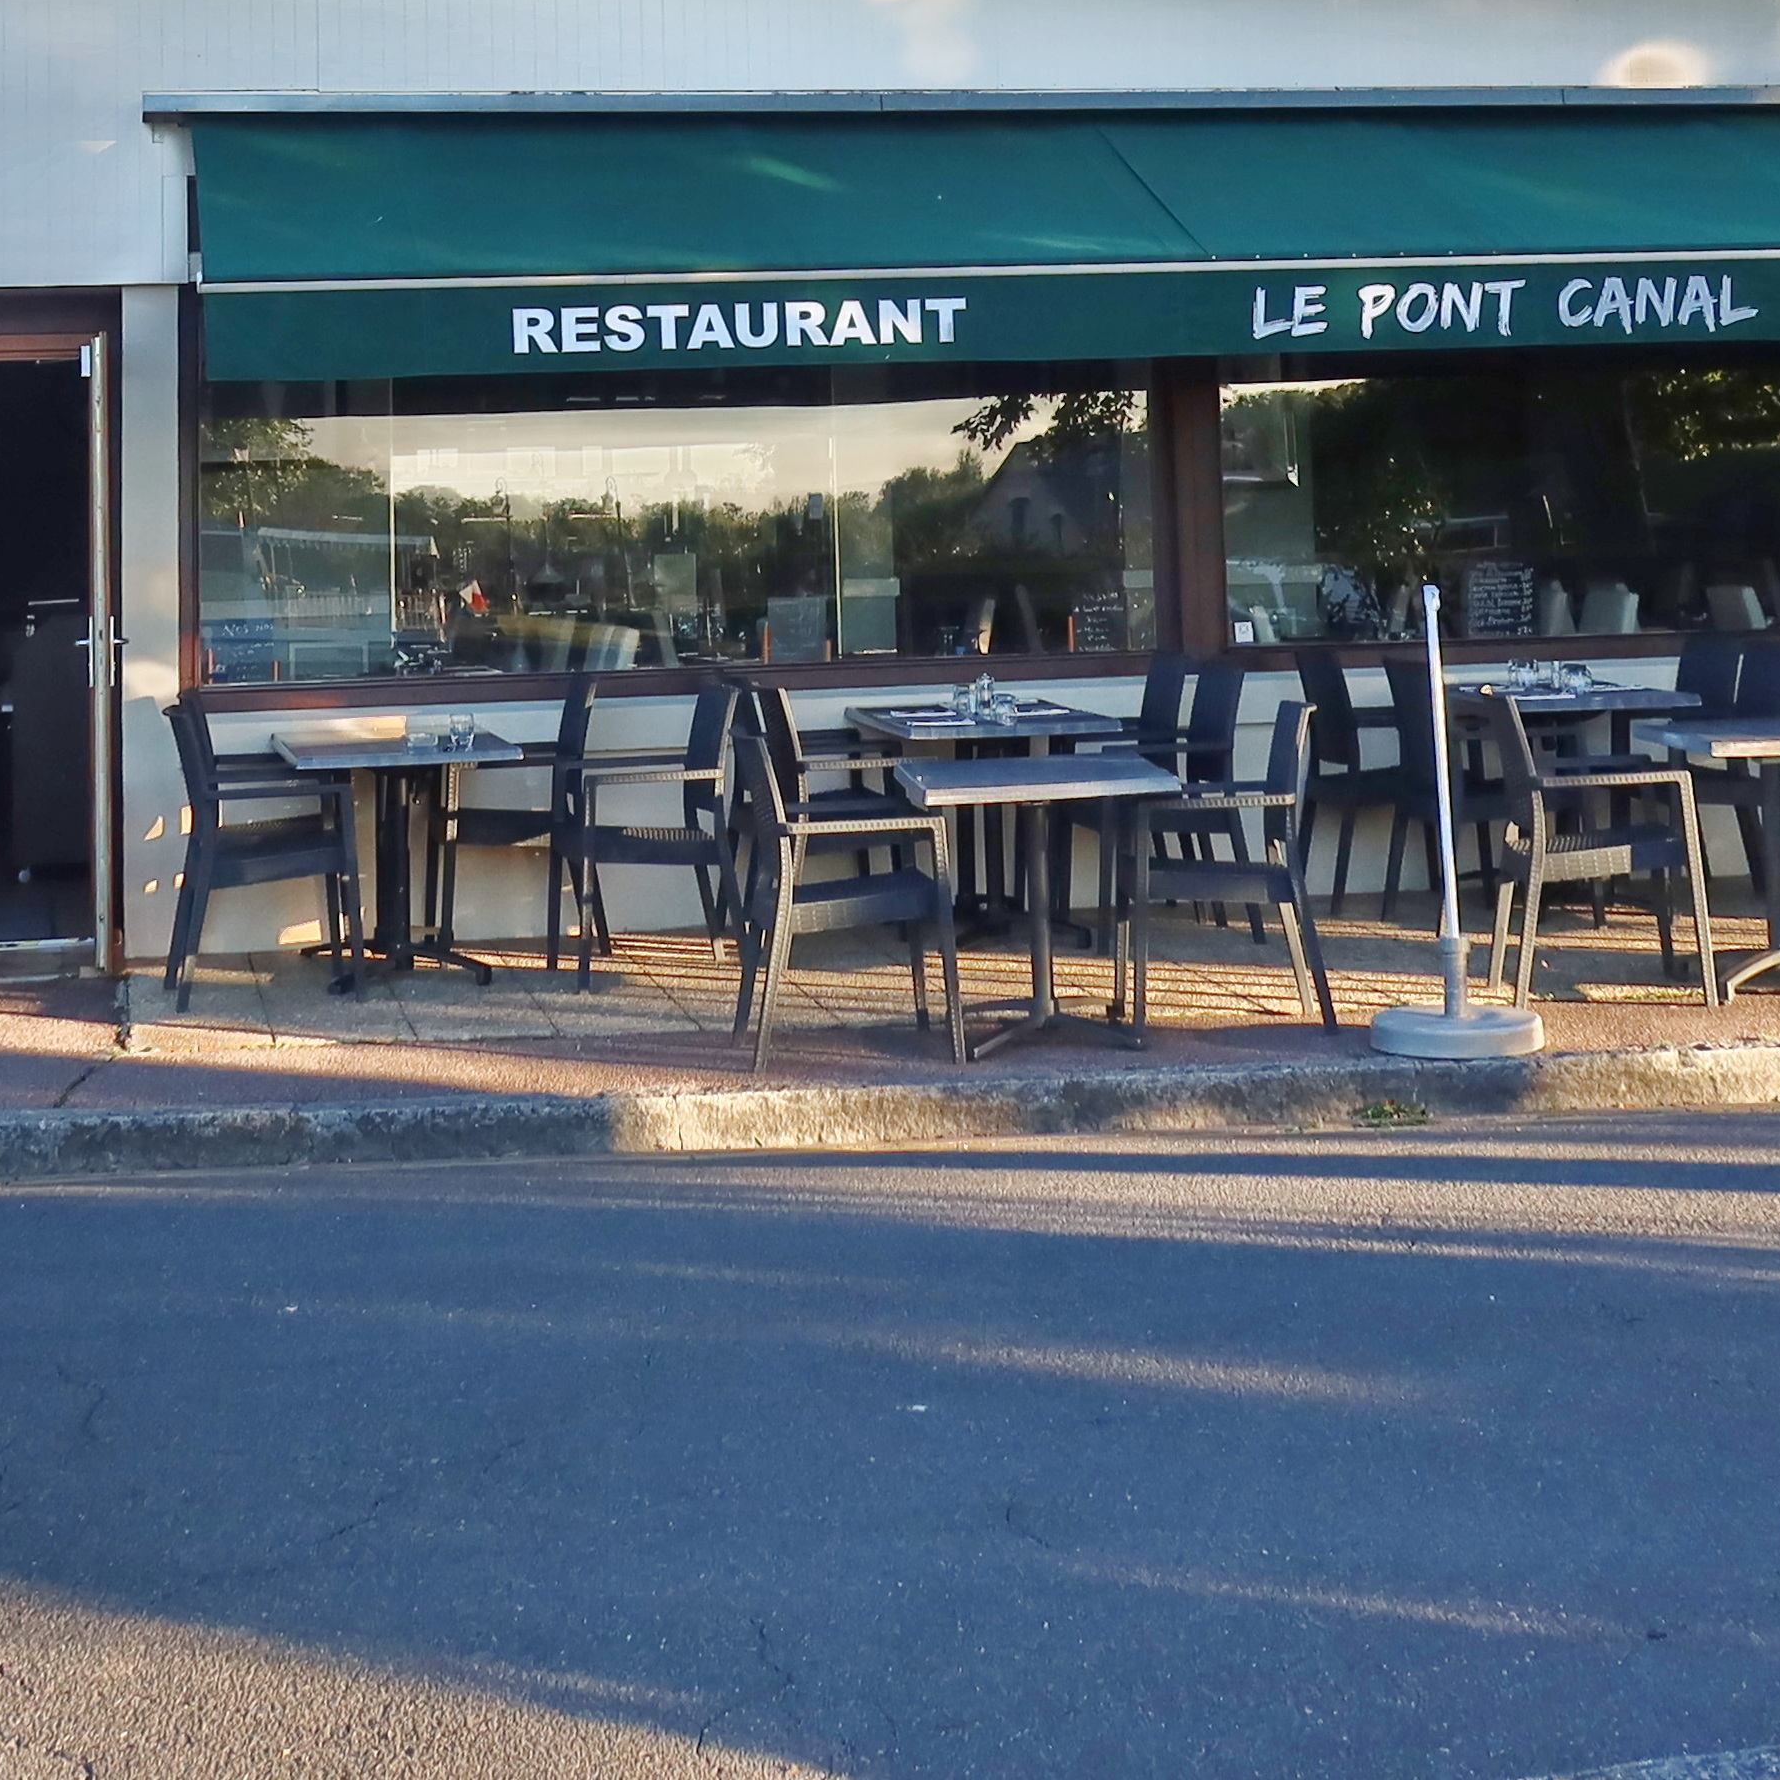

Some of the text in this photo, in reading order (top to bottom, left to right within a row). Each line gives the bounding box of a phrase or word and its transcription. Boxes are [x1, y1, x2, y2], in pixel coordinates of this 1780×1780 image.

[510, 297, 967, 355] RESTAURANT
[1251, 274, 1760, 340] LE PONT CANAL
